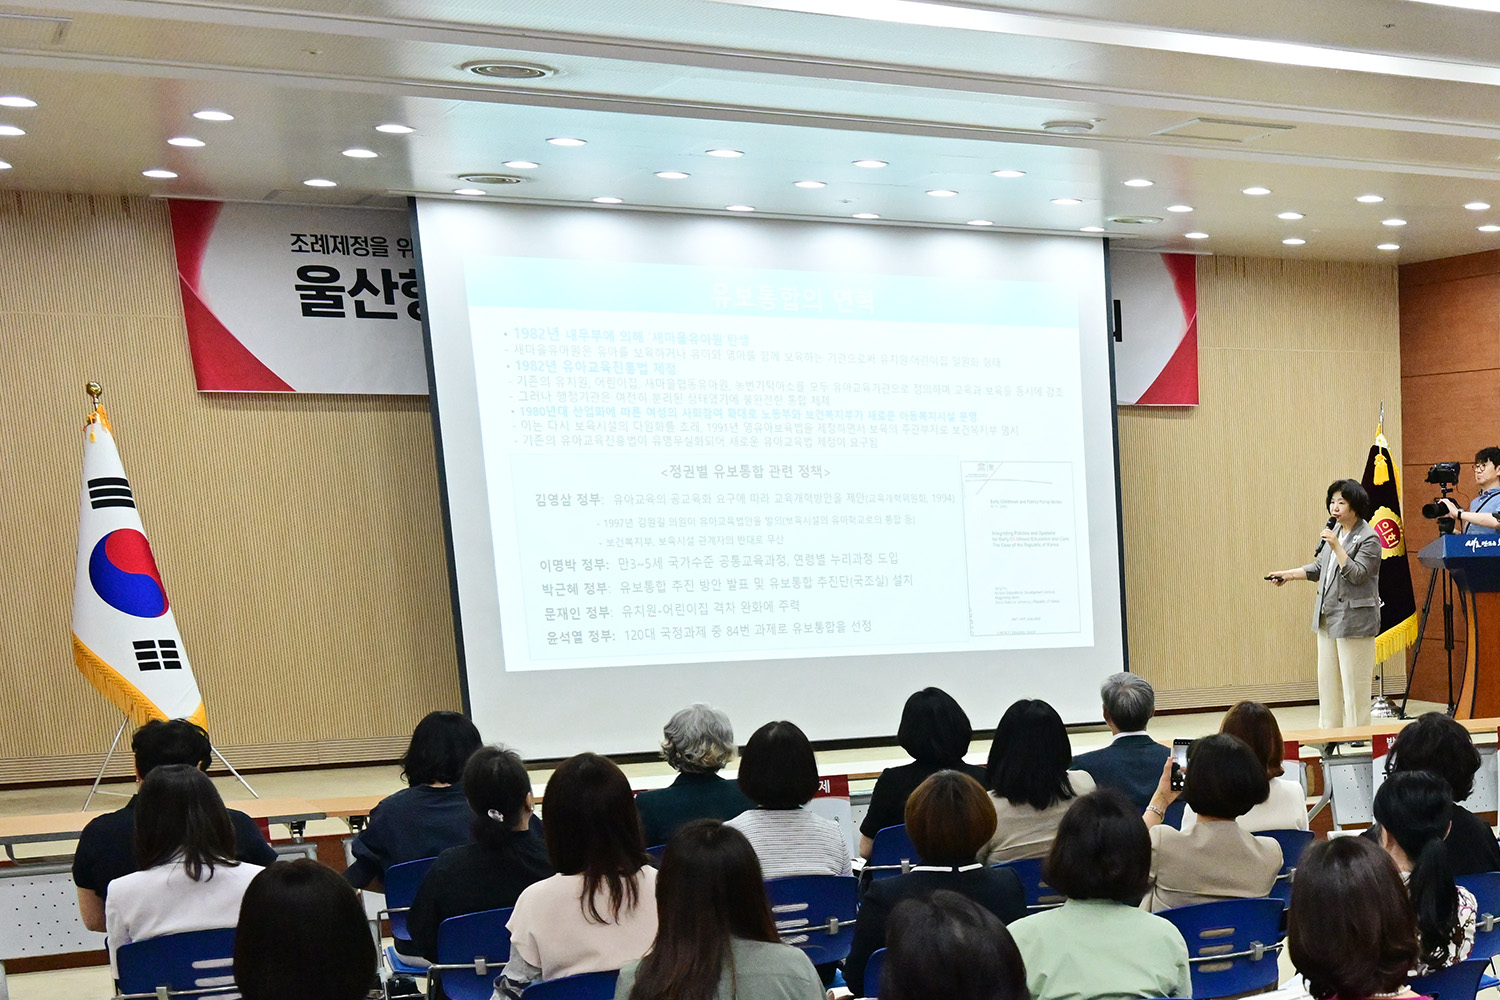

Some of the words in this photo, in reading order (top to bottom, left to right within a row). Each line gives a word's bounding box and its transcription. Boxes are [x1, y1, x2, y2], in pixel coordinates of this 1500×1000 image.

[290, 233, 389, 258] 조례제정을
[397, 237, 415, 259] 위
[711, 281, 823, 313] 유보통합의
[832, 287, 876, 315] 연혁
[515, 359, 557, 373] 1982년
[562, 359, 648, 375] 유아교육진흥법
[653, 361, 676, 375] 제정
[661, 464, 708, 479] <정권별
[714, 464, 764, 479] 유보통합
[768, 464, 793, 479] 관련
[798, 464, 830, 478] 정책>
[1377, 521, 1399, 547] 의회
[539, 558, 577, 572] 이명박
[581, 558, 609, 571] 정부:
[617, 556, 663, 571] 만3~5세
[668, 554, 714, 569] 국가수준
[793, 552, 825, 567] 연령별
[830, 552, 873, 565] 누리과정
[878, 551, 898, 565] 도입
[541, 582, 579, 597] 박근혜
[584, 581, 610, 595] 정부:
[620, 579, 666, 594] 유보통합
[672, 578, 694, 593] 추진
[699, 578, 722, 592] 방안
[726, 578, 748, 591] 발표
[753, 576, 764, 590] 및
[769, 575, 812, 590] 유보통합
[892, 573, 913, 587] 설치
[544, 606, 581, 621] 문재인
[586, 605, 613, 619] 정부:
[622, 602, 708, 618] 유치원-어린이집
[714, 601, 735, 614] 격차
[740, 600, 774, 614] 완화에
[778, 598, 800, 612] 주력
[546, 630, 583, 645] 윤석열
[588, 629, 616, 643] 정부:
[624, 627, 656, 641] 120대
[660, 625, 707, 640] 국정과제
[711, 624, 721, 638] 중
[726, 624, 750, 638] 84번
[754, 622, 787, 635] 과제로
[792, 620, 846, 635] 유보통합을
[851, 619, 871, 633] 선정
[817, 779, 831, 794] 제
